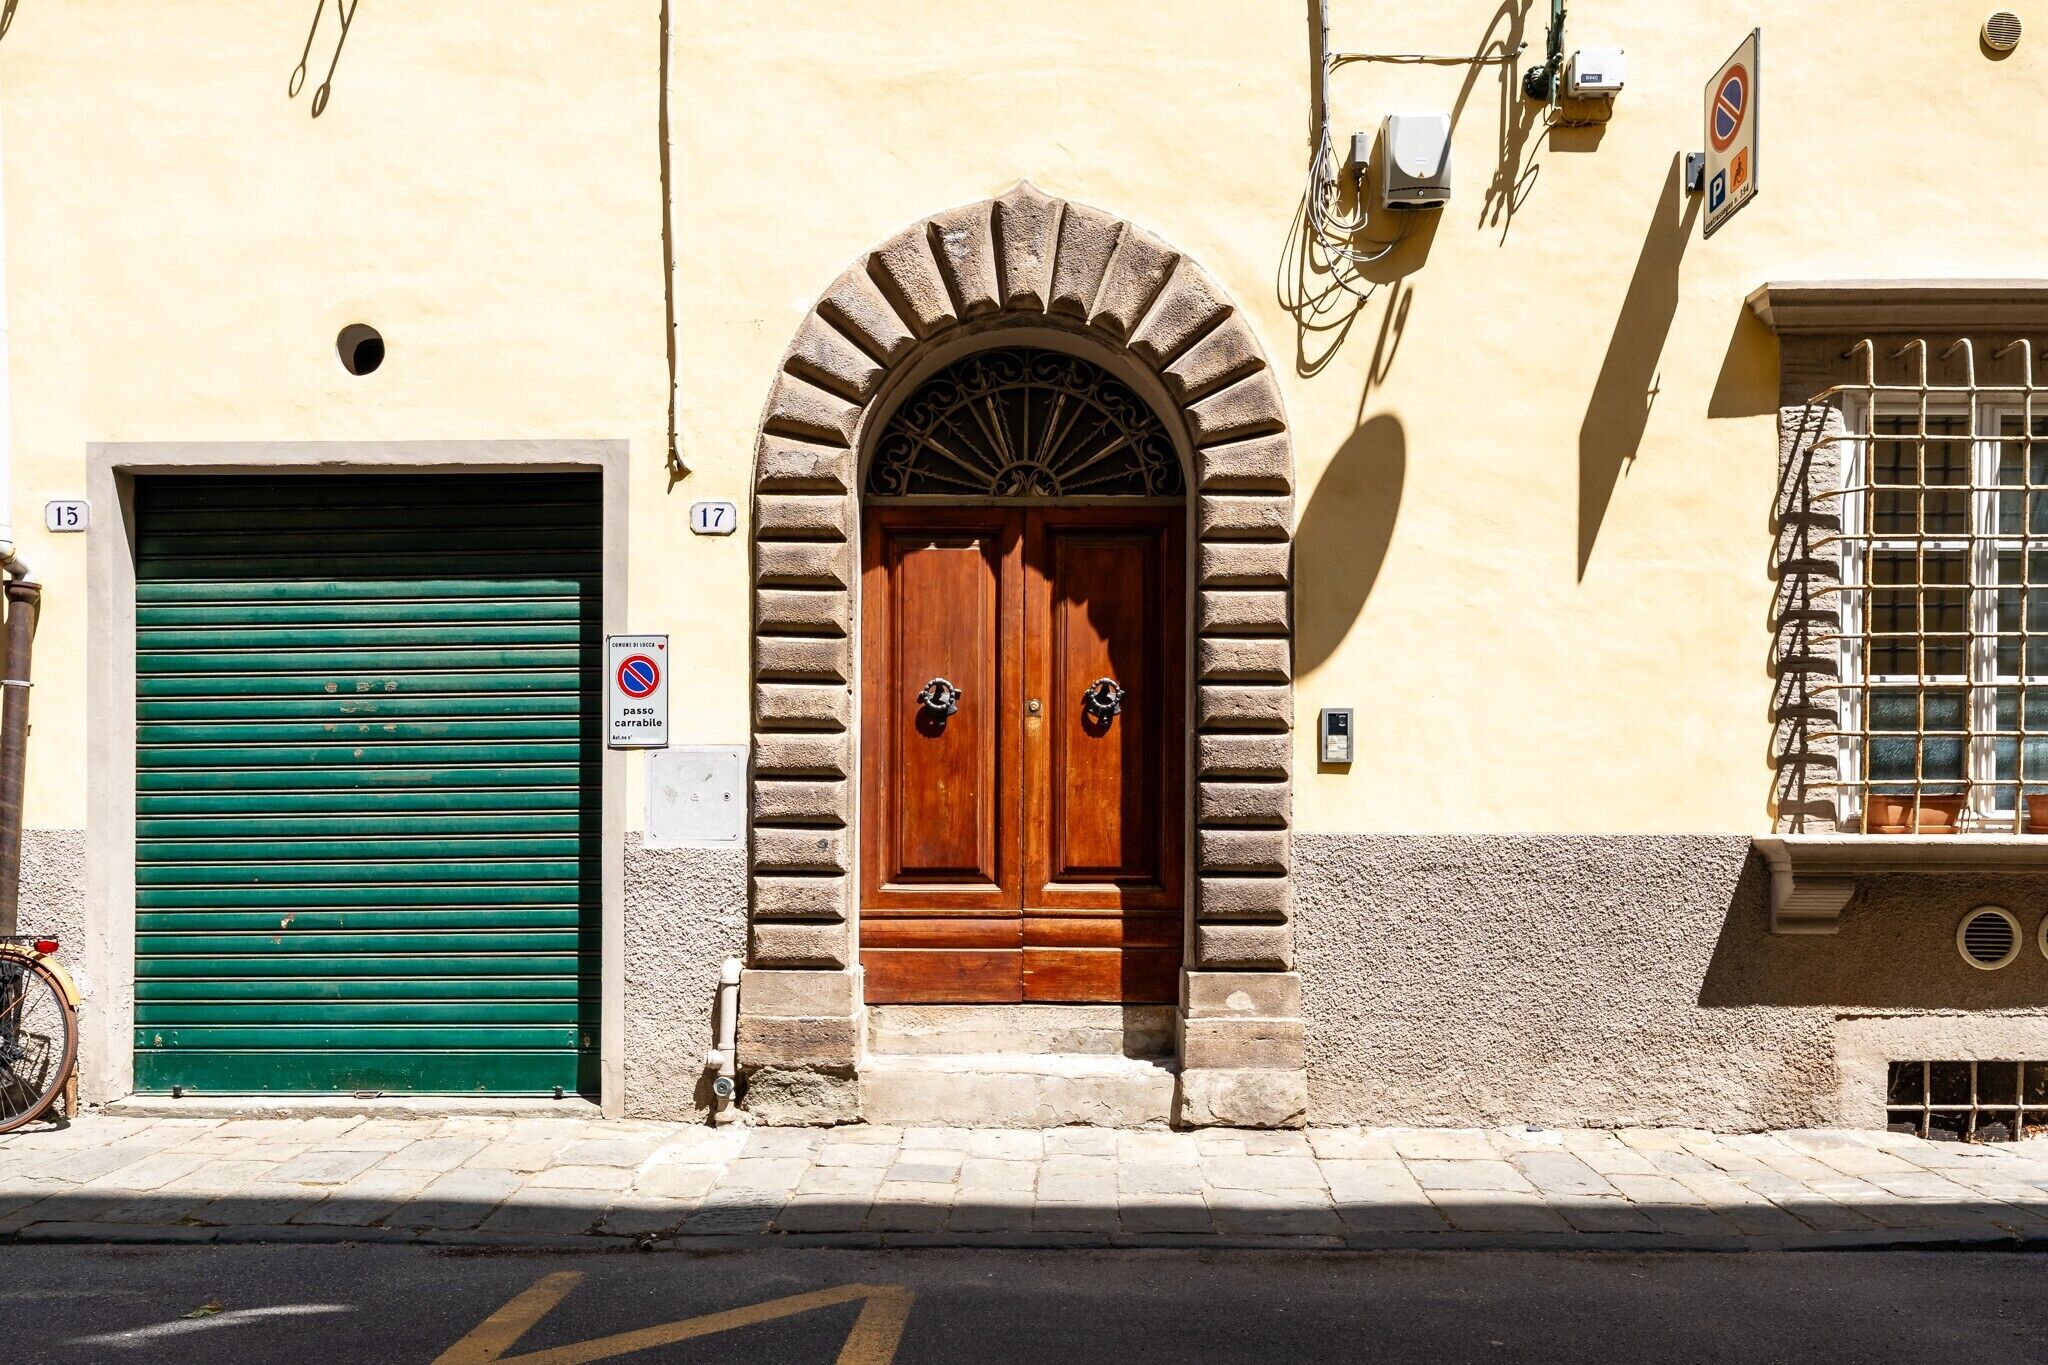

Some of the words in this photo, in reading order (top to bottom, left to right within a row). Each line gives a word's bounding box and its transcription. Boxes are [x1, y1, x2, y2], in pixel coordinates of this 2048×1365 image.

[1713, 177, 1723, 207] P
[56, 506, 78, 526] 15
[702, 507, 725, 527] 17
[623, 707, 654, 716] passo
[614, 718, 662, 727] carrabile
